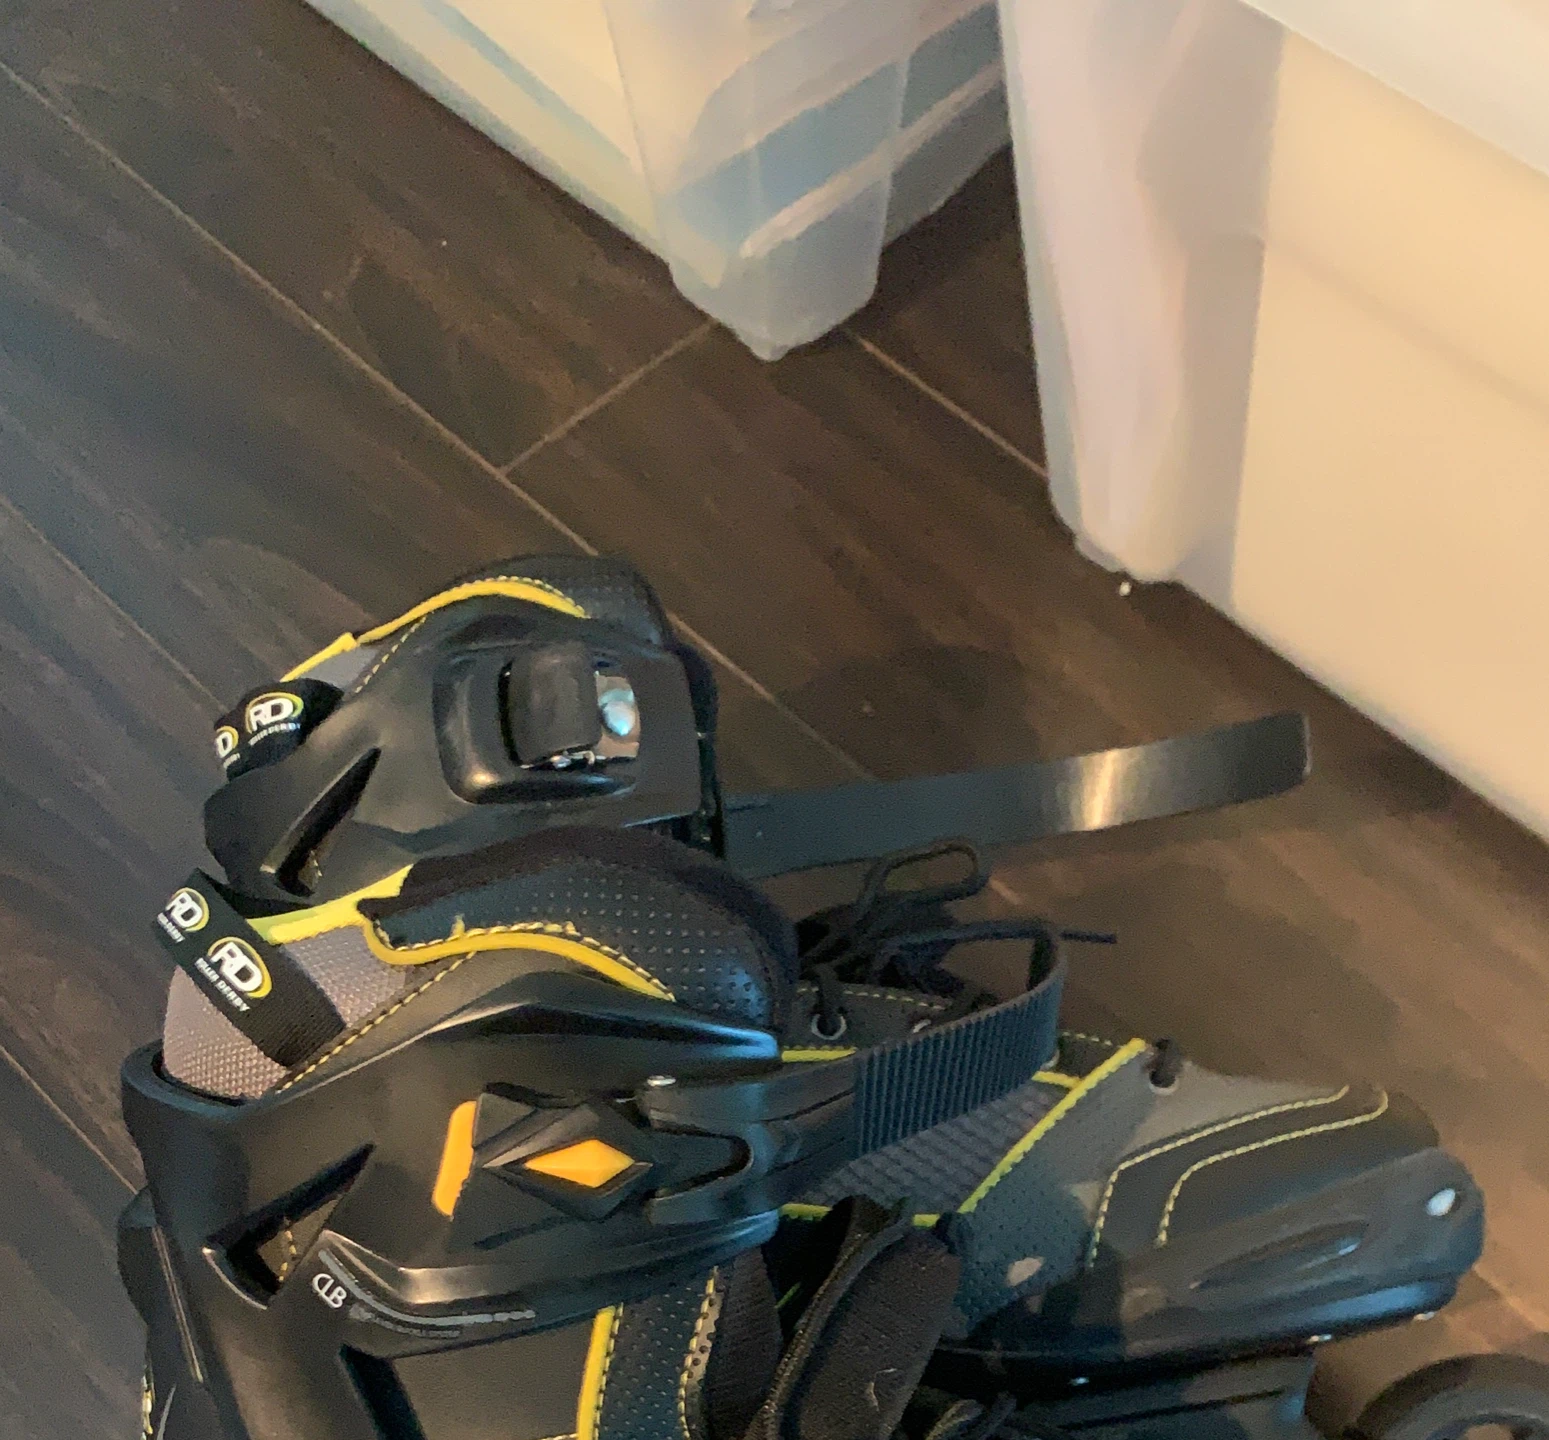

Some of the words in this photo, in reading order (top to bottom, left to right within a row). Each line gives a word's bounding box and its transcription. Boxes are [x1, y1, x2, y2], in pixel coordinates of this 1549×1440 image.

[249, 697, 295, 732] RD
[165, 891, 204, 928] RD
[209, 941, 263, 992] RD
[311, 1272, 348, 1309] CLB
